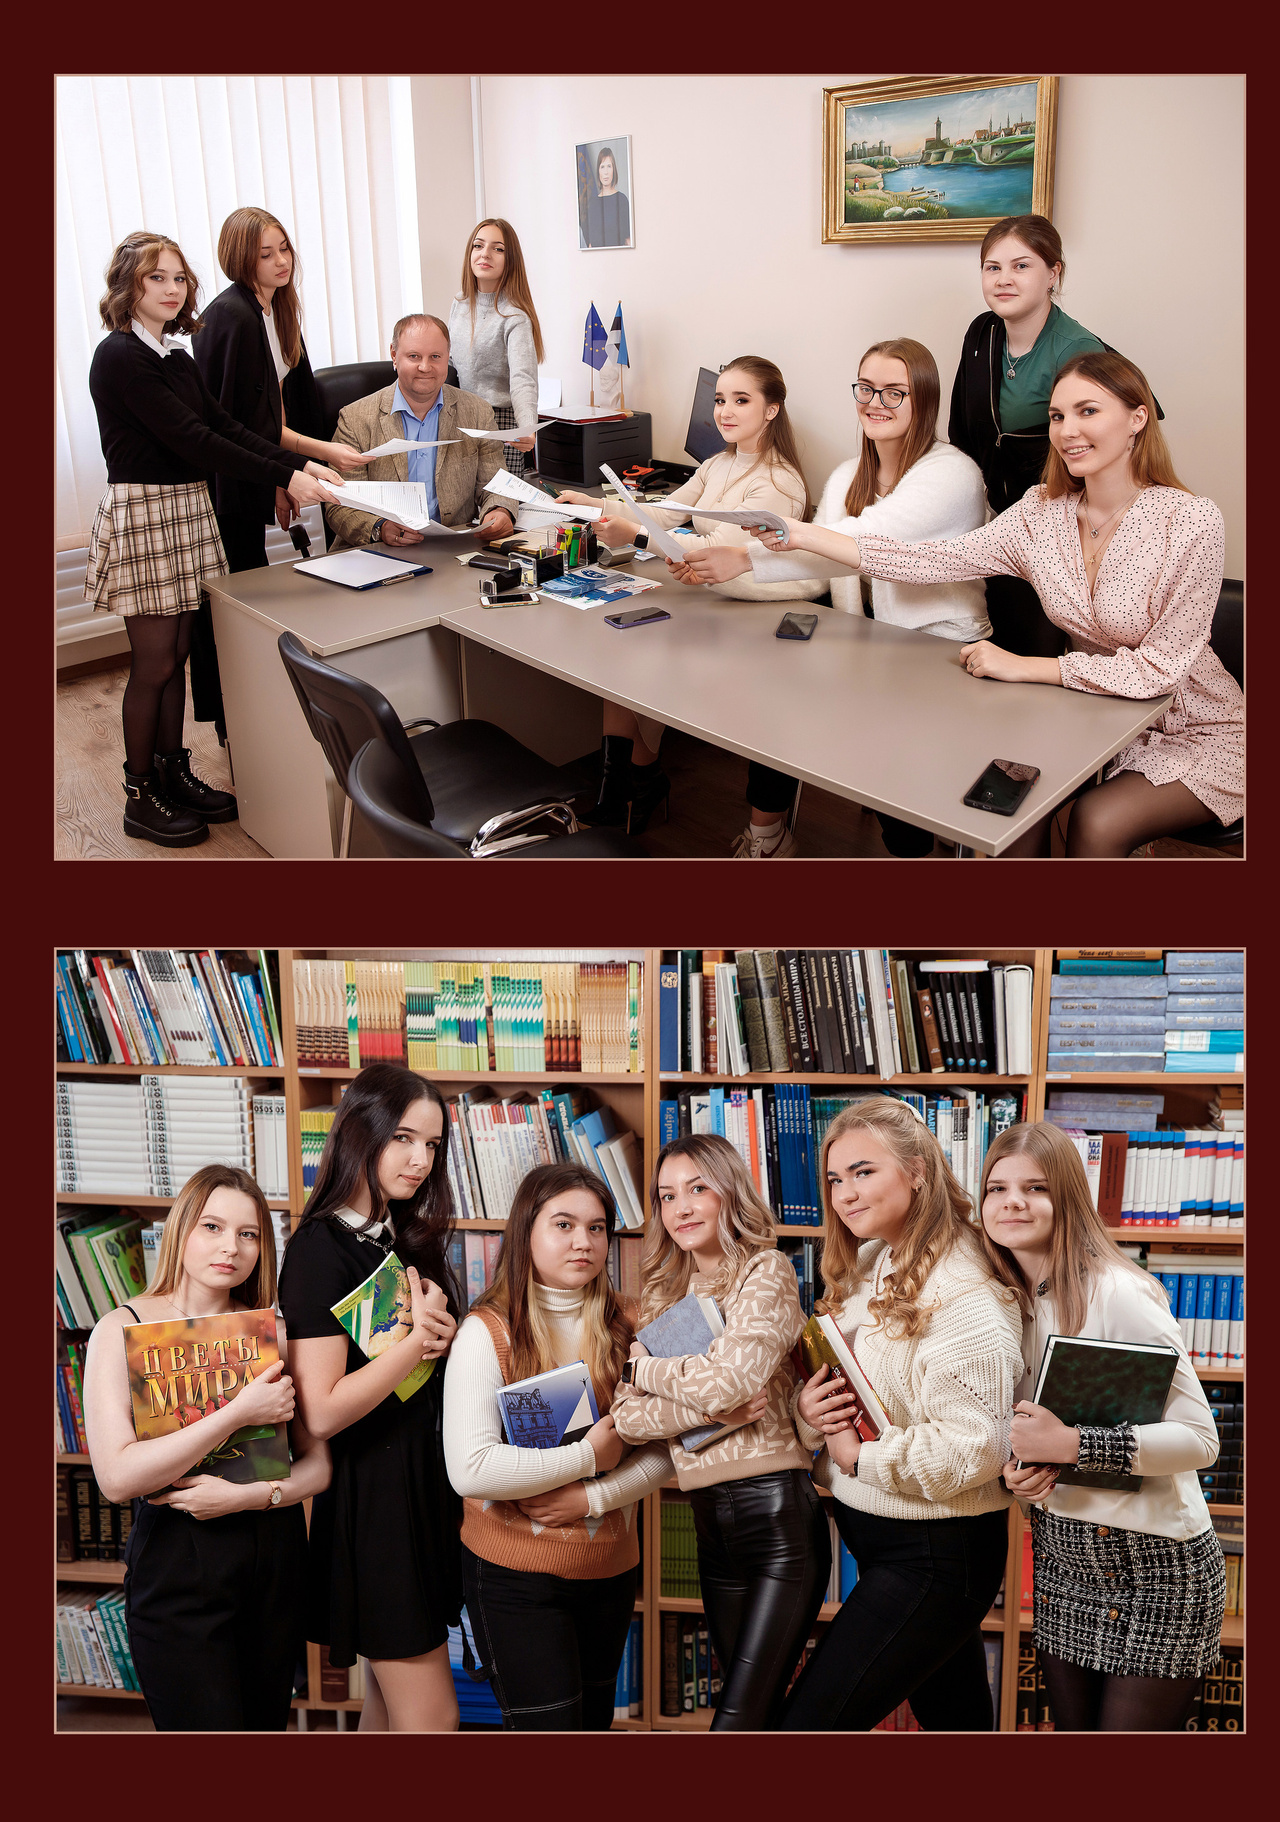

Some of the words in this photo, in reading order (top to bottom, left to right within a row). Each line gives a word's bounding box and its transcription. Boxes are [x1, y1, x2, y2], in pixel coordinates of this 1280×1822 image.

[789, 958, 799, 985] МИРА
[793, 986, 807, 1031] СТОЛИЦЫ
[801, 1032, 809, 1050] ВСЕ
[142, 1336, 261, 1379] ЦВЕТЫ
[145, 1364, 255, 1418] МИРА
[1019, 1648, 1036, 1692] ENE
[1224, 1660, 1244, 1706] EE
[1021, 1708, 1030, 1724] 1
[1042, 1706, 1049, 1722] 1
[1207, 1718, 1219, 1731] 8
[1225, 1718, 1238, 1731] 9
